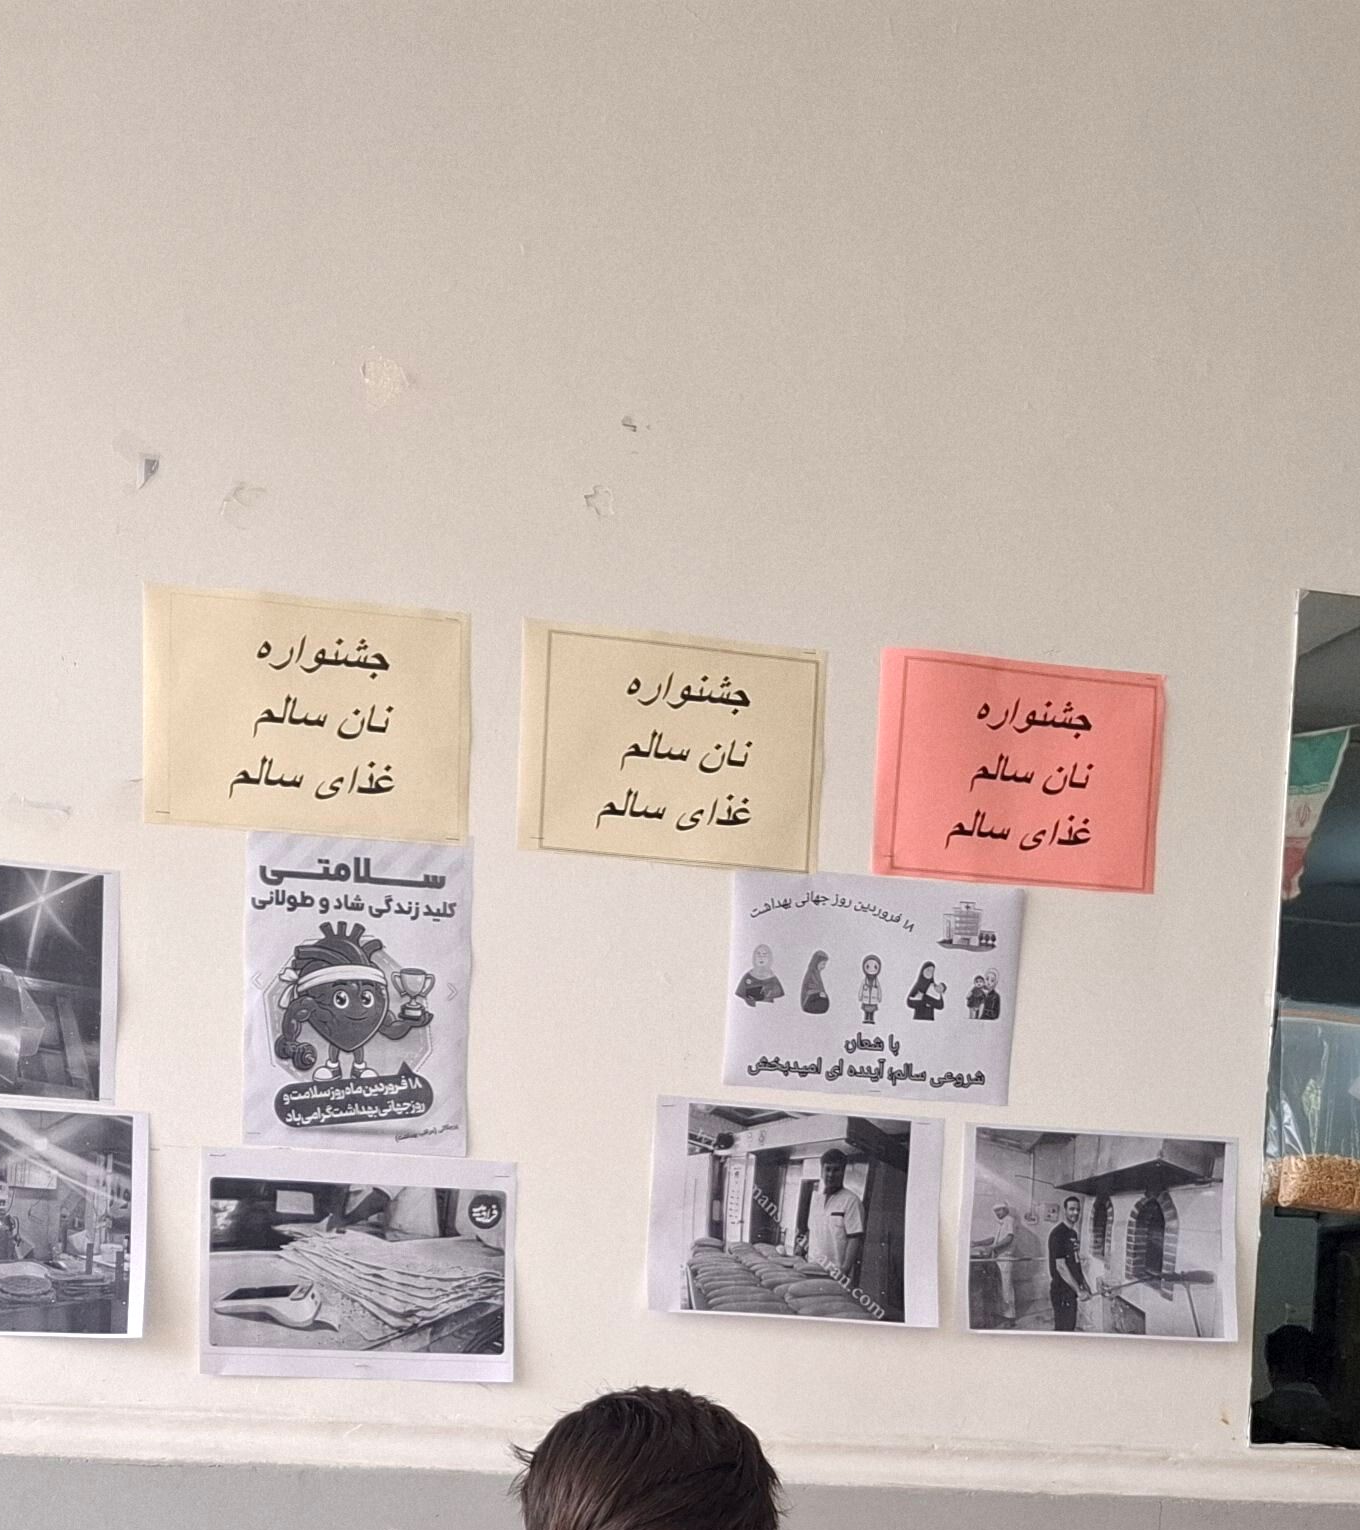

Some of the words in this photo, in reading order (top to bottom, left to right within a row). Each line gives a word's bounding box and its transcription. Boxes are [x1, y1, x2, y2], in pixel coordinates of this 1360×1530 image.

[256, 634, 390, 680] جشنواره
[626, 671, 751, 716] جشنواره
[252, 693, 328, 738] سالم
[337, 704, 394, 740] نان
[977, 697, 1093, 740] جشنواره
[620, 729, 691, 771] سالم
[698, 739, 753, 774] نان
[228, 754, 305, 799] سالم
[314, 760, 396, 800] غذای
[969, 752, 1035, 792] سالم
[1042, 762, 1095, 796] نان
[595, 787, 667, 830] سالم
[675, 794, 752, 831] غذای
[944, 808, 1011, 850] سالم
[1019, 814, 1091, 851] غذای
[250, 888, 316, 912] طولانی
[318, 897, 331, 914] و
[333, 894, 365, 912] شاد
[368, 894, 421, 921] زندگی
[750, 897, 792, 919] بهداشت
[794, 890, 830, 908] جهانی
[831, 893, 852, 908] روز
[423, 901, 458, 922] کلید
[853, 901, 902, 924] فروردین
[847, 1058, 886, 1082] آینده
[930, 1069, 985, 1088] شروعی
[290, 1086, 330, 1100] سلامت
[330, 1086, 345, 1100] روز
[345, 1082, 362, 1095] ماه
[363, 1075, 408, 1096] فروردین
[333, 1103, 379, 1118] بهداشت
[378, 1100, 411, 1117] جهانی
[411, 1100, 425, 1113] روز
